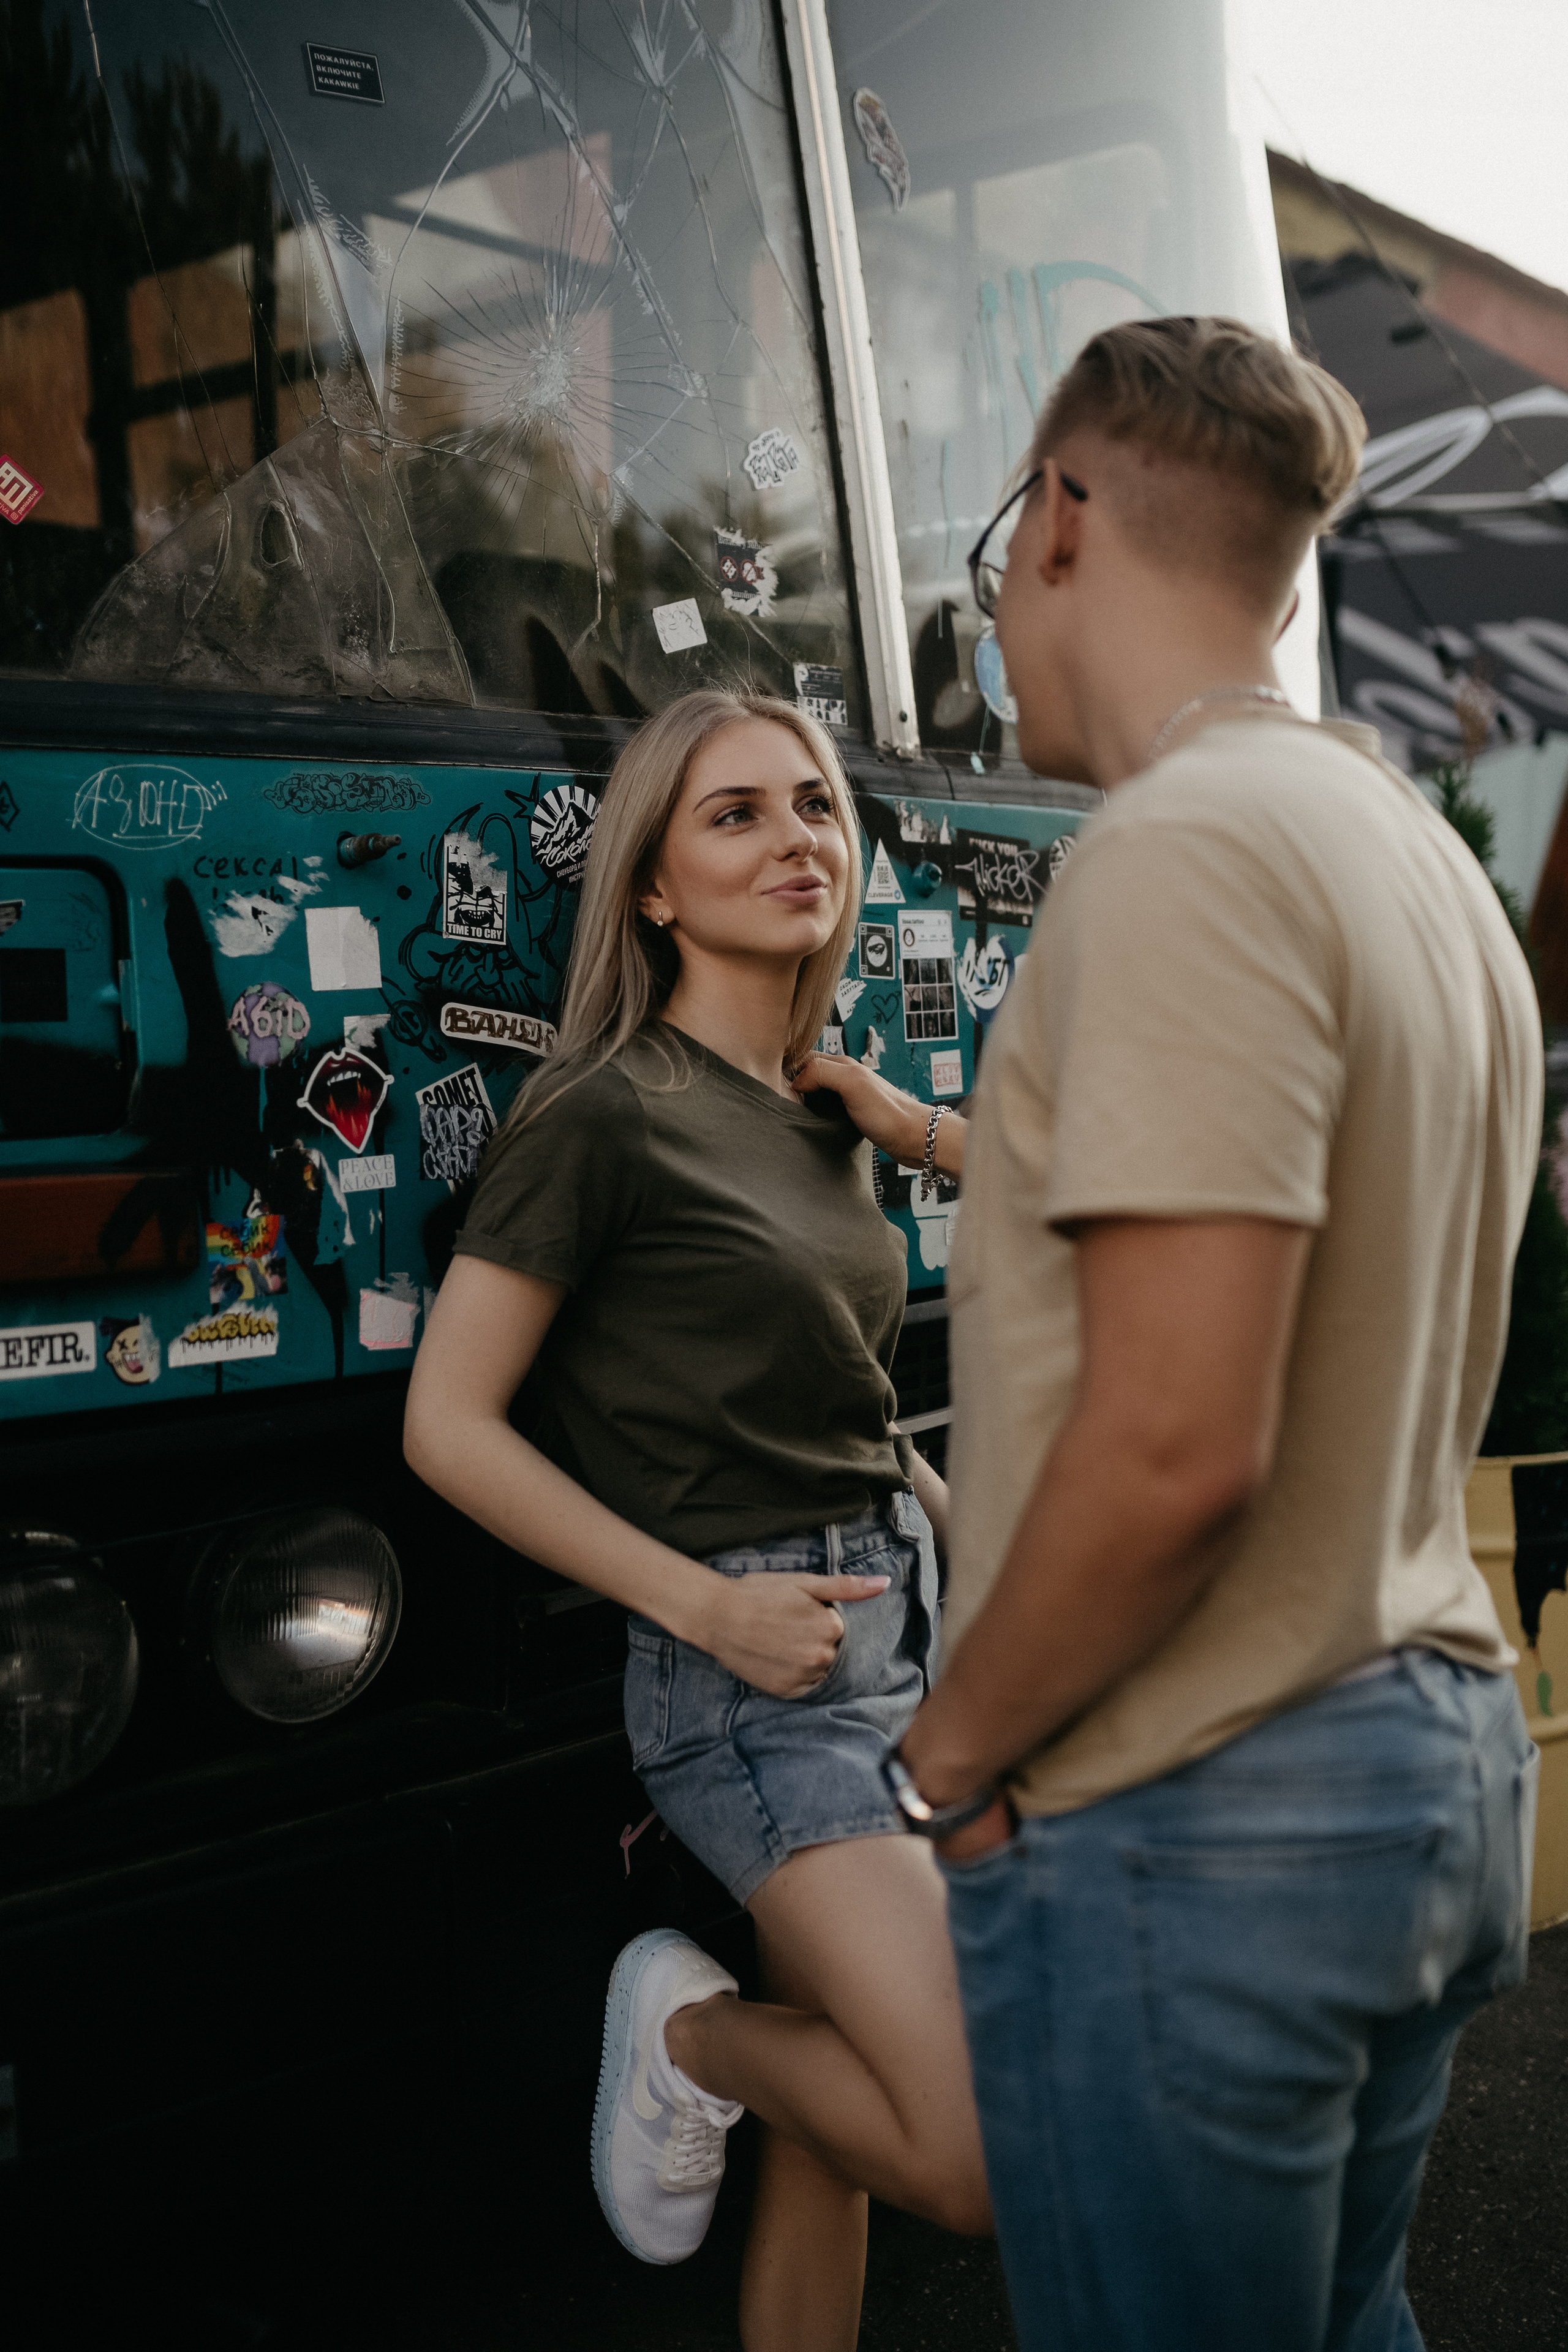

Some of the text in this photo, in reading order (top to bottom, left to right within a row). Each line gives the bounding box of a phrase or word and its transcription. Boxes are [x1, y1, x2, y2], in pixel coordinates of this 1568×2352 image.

[314, 53, 374, 70] ПОЖАЛУЙСТА,
[315, 64, 362, 80] ВКЛЮЧИТЕ
[17, 489, 39, 515] panisativa
[556, 864, 578, 878] СНОУБОРД
[447, 923, 503, 940] TIME TO CRY
[341, 1155, 393, 1174] PEACE
[0, 1331, 91, 1369] EFIR.
